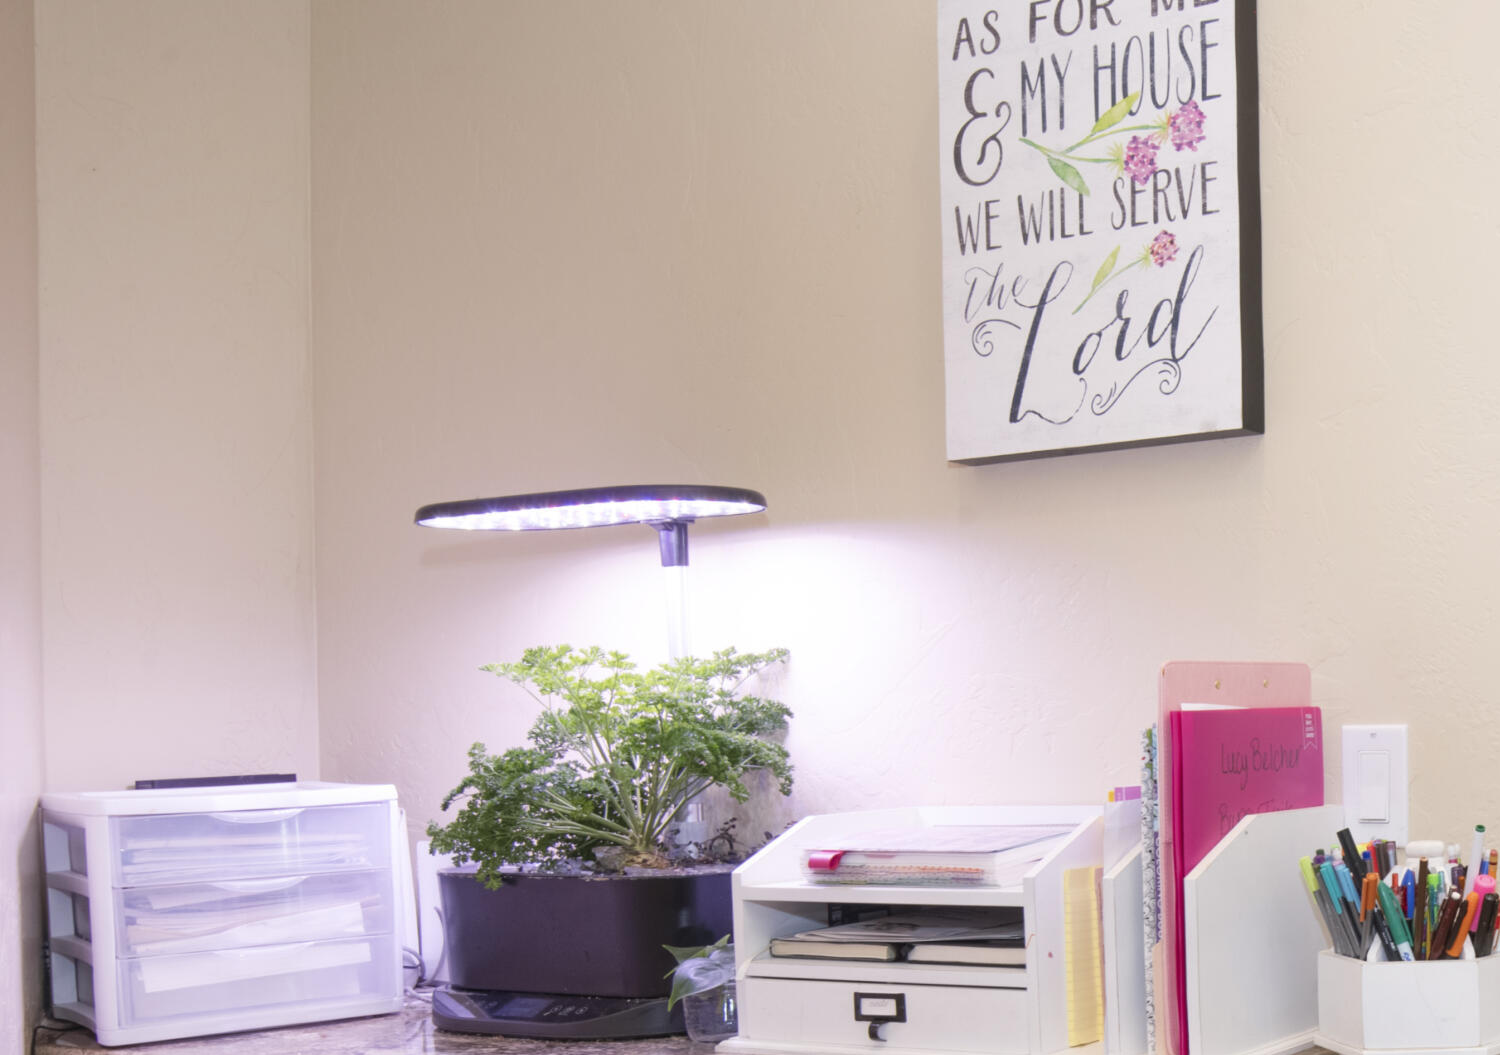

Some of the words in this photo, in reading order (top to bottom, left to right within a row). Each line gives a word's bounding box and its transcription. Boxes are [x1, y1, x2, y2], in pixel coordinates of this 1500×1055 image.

[952, 10, 1001, 61] AS
[1029, 0, 1122, 44] FOR
[953, 68, 1012, 187] &
[1020, 50, 1073, 137] MY
[1092, 19, 1223, 124] HOUSE
[954, 199, 1002, 256] WE
[1018, 186, 1094, 246] WILL
[1110, 161, 1221, 231] SERVE
[1009, 244, 1220, 425] Lord
[1220, 744, 1249, 791] Lucy
